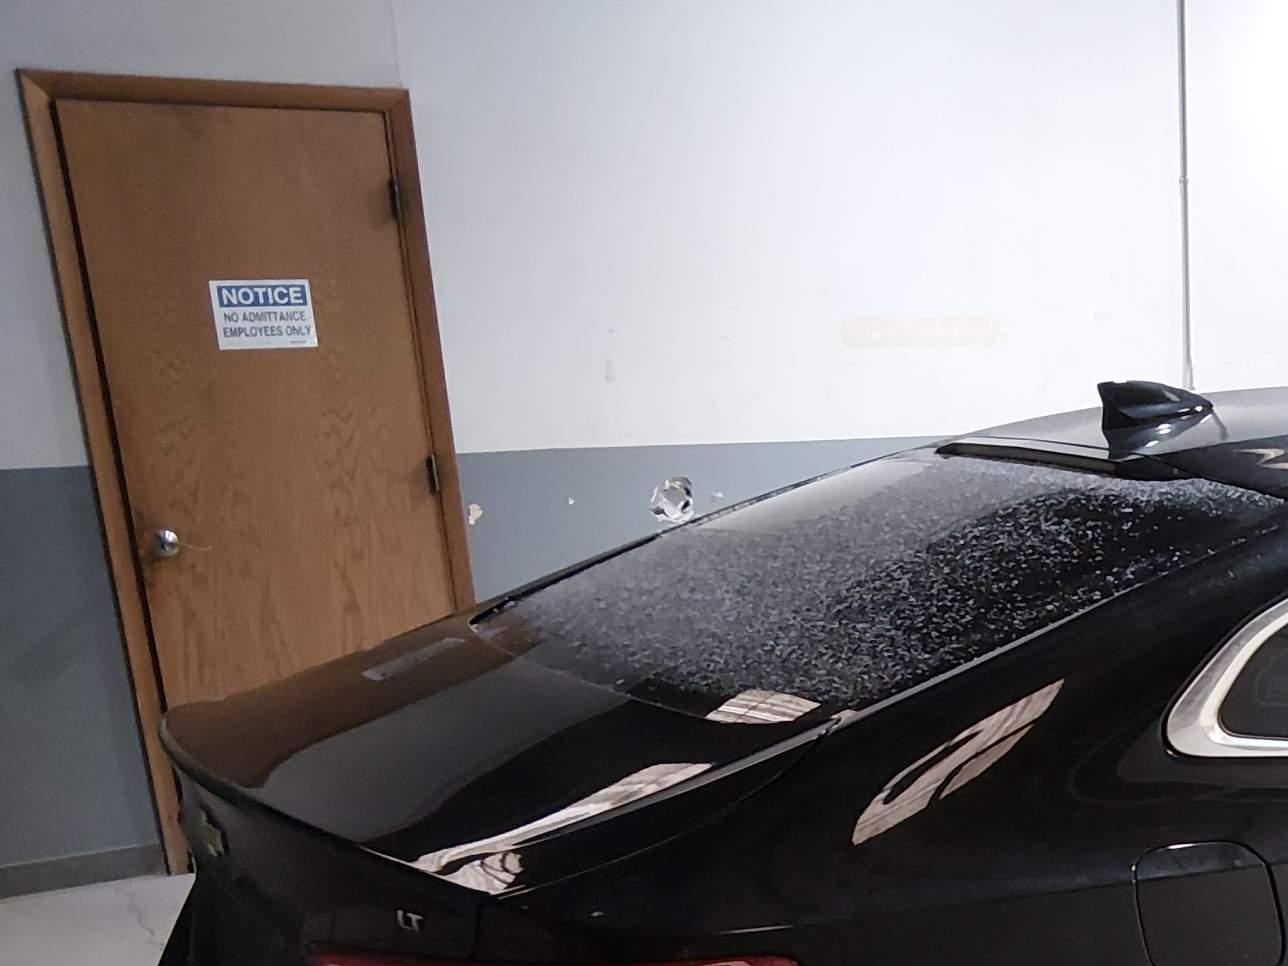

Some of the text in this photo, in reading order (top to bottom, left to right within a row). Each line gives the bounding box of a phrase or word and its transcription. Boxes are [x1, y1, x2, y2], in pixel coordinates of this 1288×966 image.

[221, 286, 304, 306] NOTICE
[223, 310, 307, 323] NO ADMITTANCE
[223, 325, 311, 338] EMPLOYEES ONLY
[396, 909, 424, 933] LT
